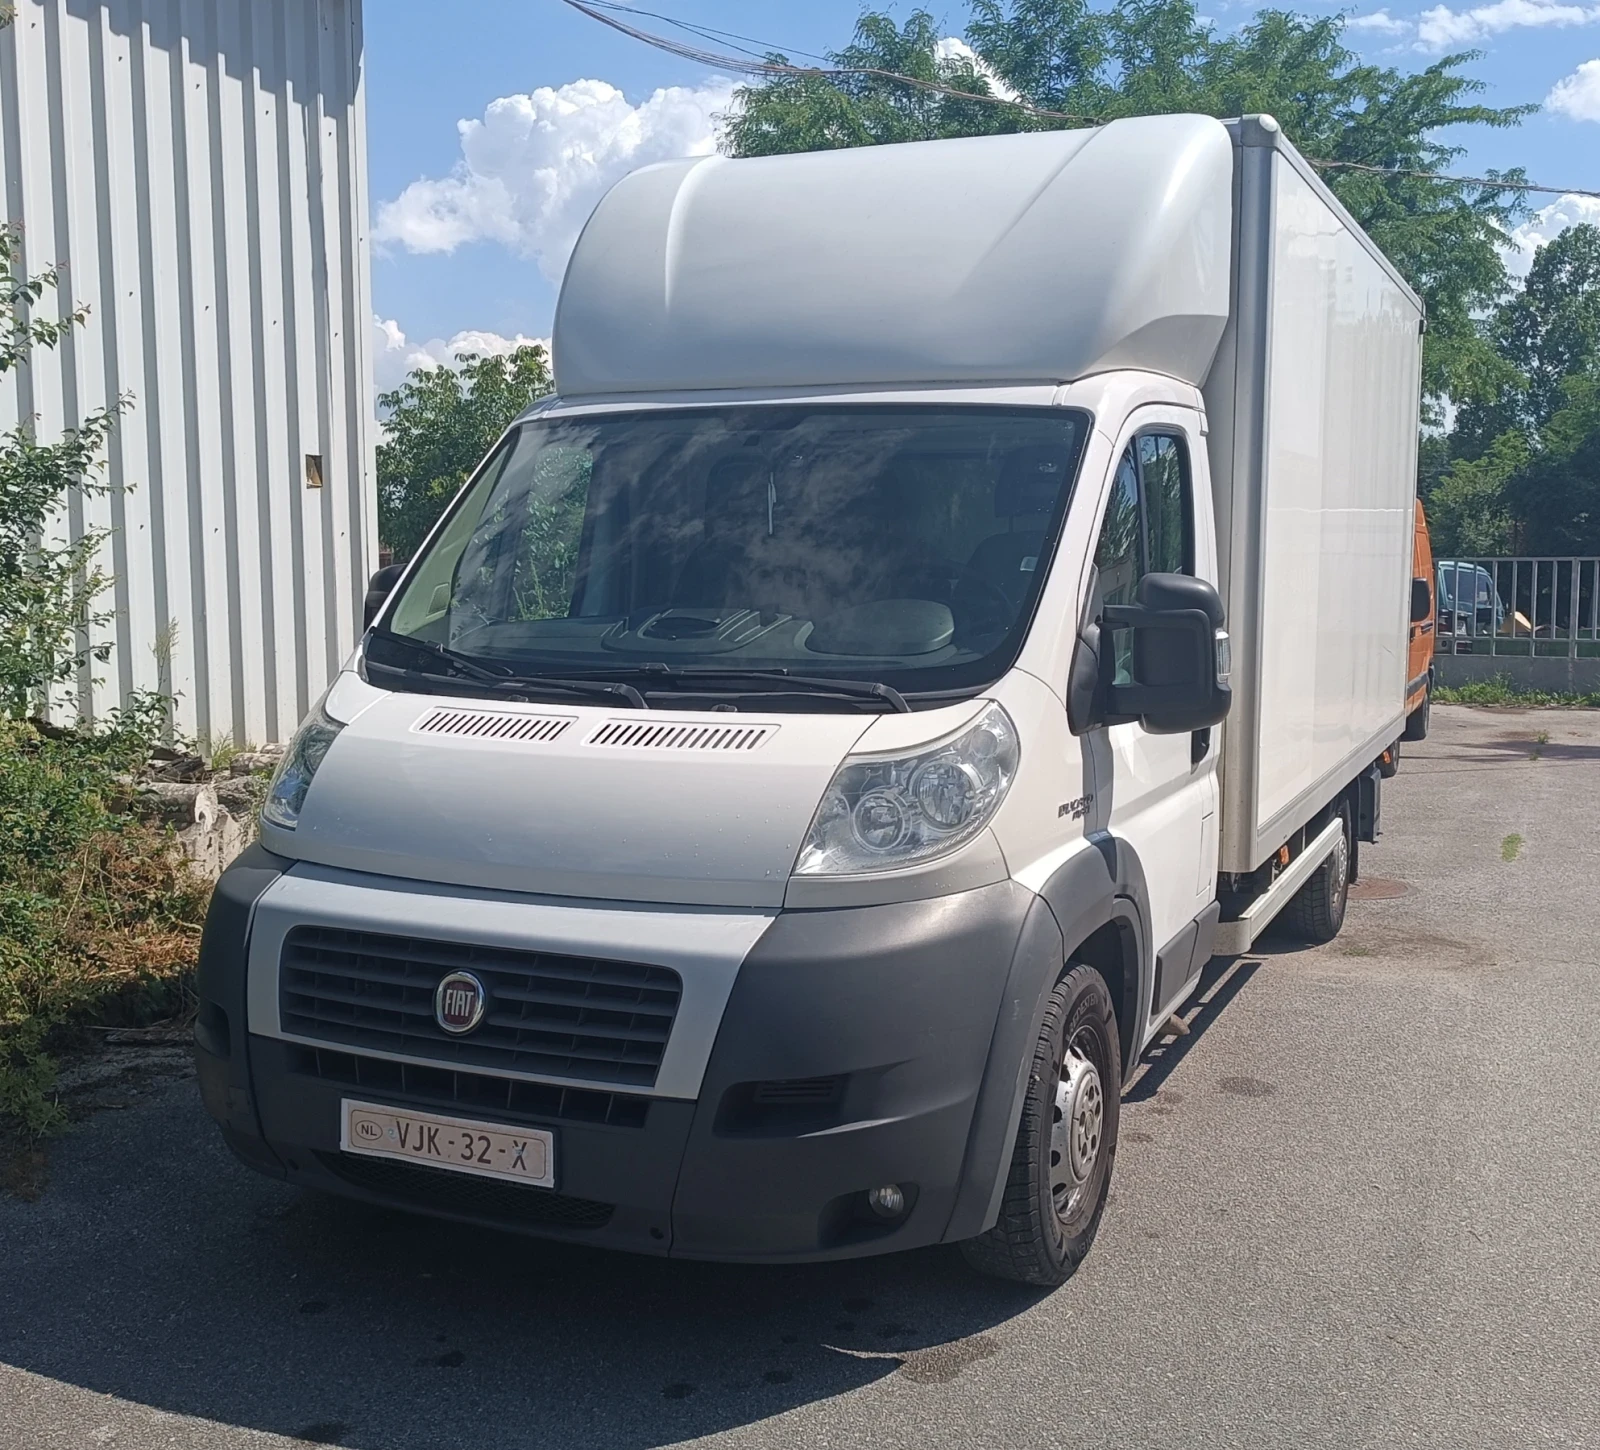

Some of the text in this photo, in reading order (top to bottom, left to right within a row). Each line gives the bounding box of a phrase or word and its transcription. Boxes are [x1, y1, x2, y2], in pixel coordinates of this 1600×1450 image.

[445, 989, 474, 1017] FIAT
[361, 1119, 527, 1171] NL VJK-32-X
